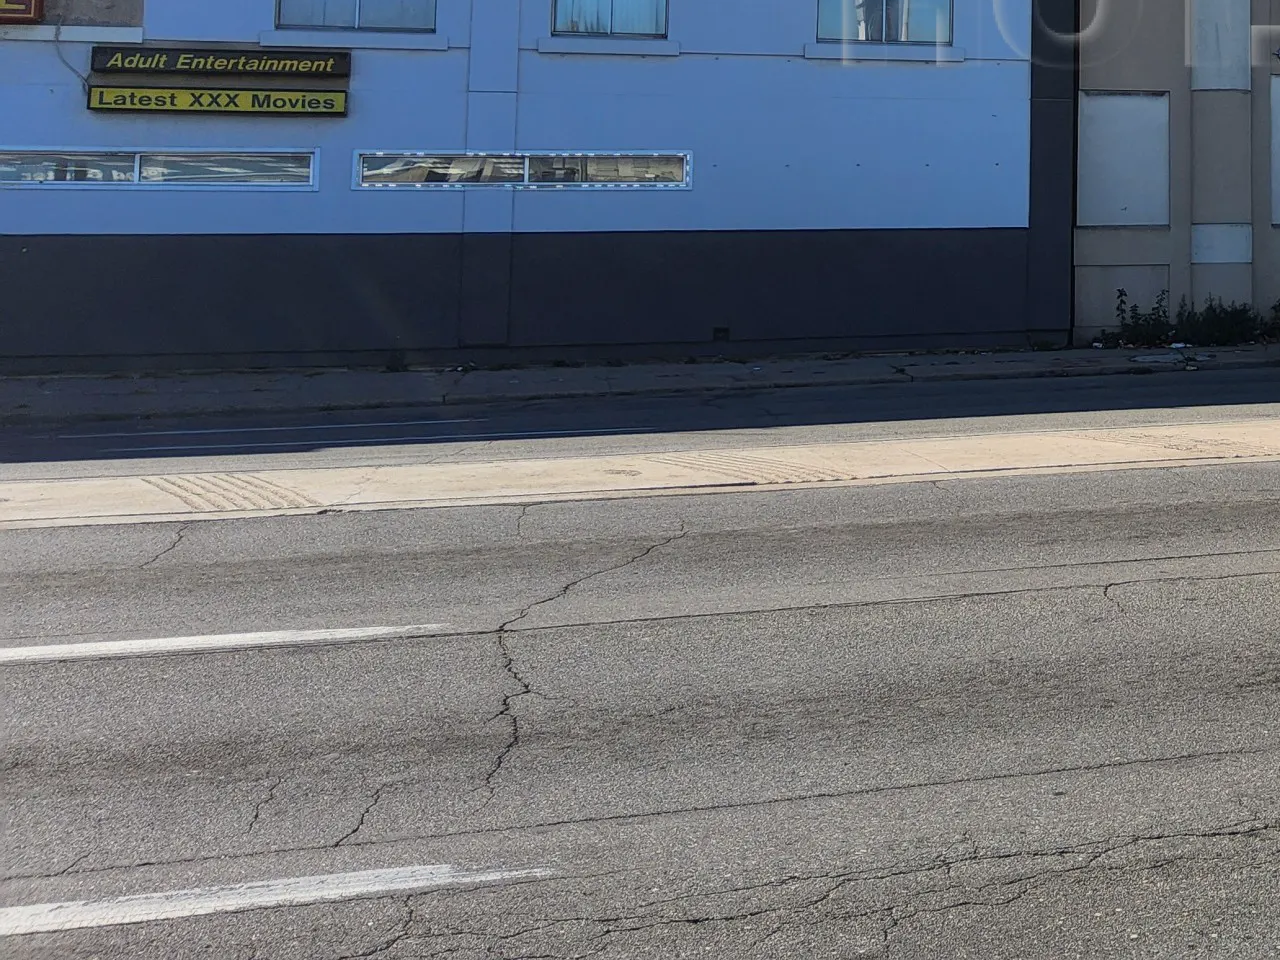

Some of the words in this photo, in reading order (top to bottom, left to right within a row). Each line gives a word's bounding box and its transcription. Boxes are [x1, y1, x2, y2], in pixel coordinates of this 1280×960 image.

[106, 52, 168, 69] Adult
[176, 54, 335, 72] Entertainment
[98, 91, 178, 107] Latest
[188, 92, 240, 108] XXX
[250, 94, 335, 110] Movies
